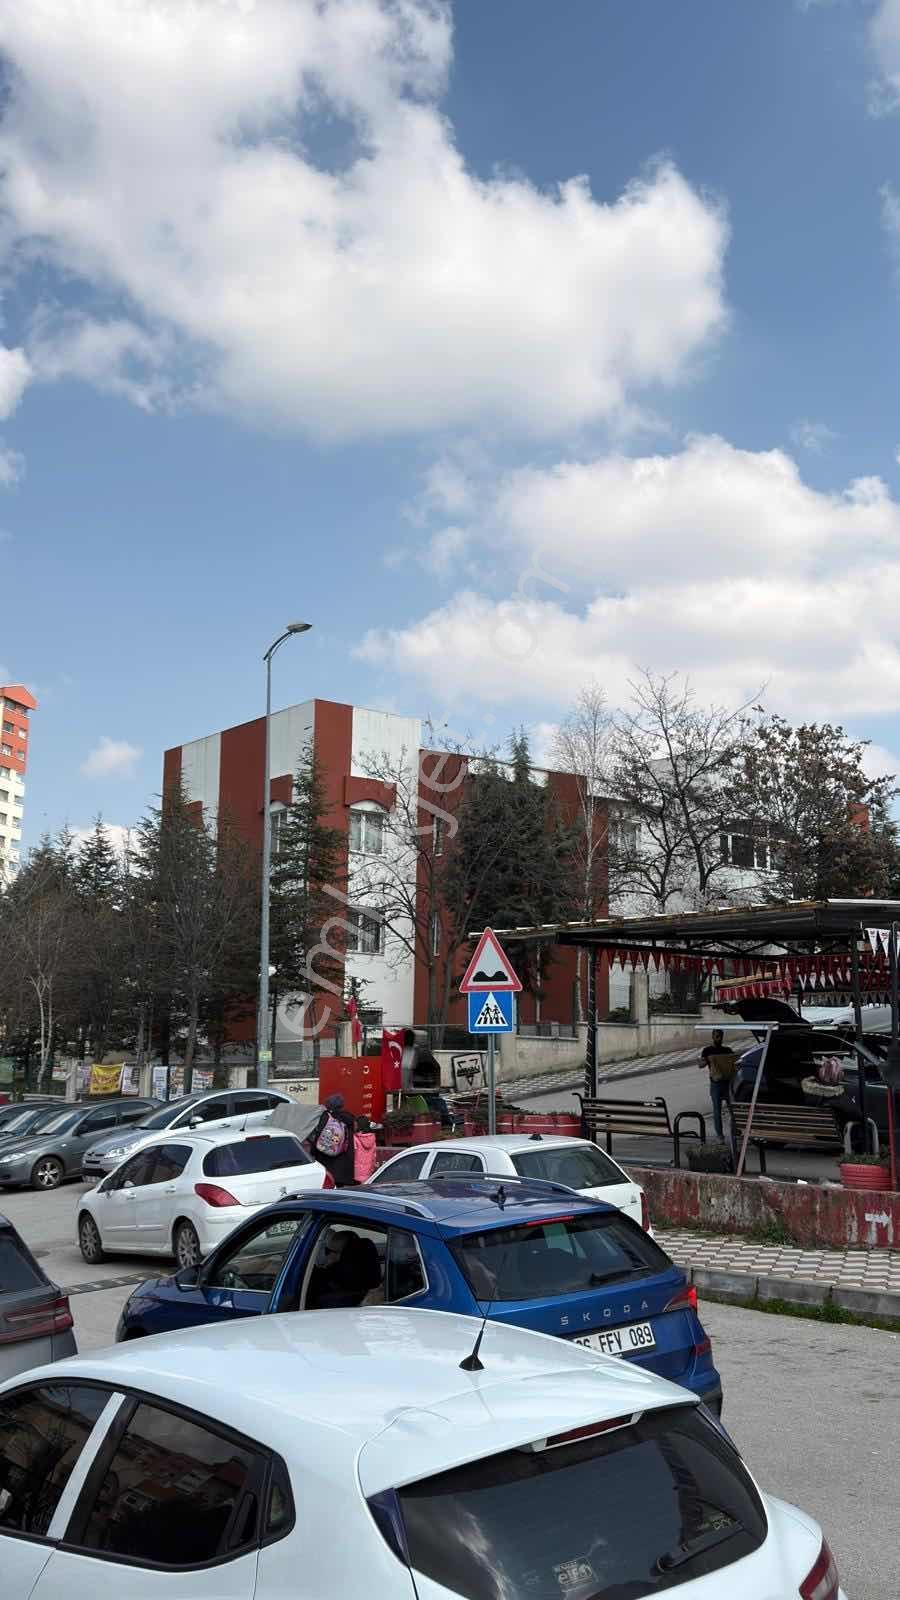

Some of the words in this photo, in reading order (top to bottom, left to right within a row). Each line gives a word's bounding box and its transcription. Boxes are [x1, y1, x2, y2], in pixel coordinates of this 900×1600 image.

[560, 1300, 648, 1325] SKODA
[599, 1331, 622, 1352] FFY
[629, 1326, 653, 1346] 089
